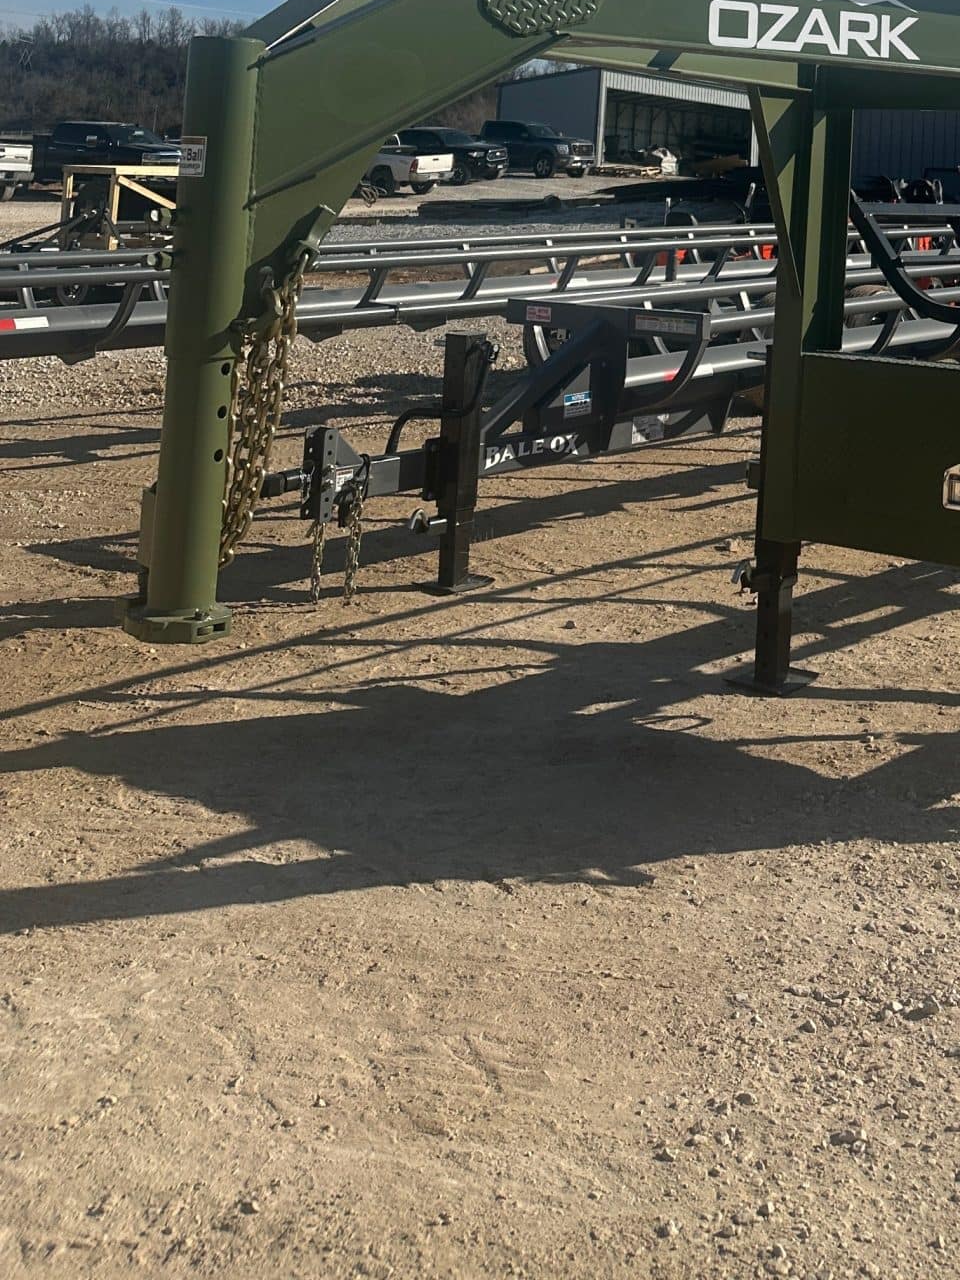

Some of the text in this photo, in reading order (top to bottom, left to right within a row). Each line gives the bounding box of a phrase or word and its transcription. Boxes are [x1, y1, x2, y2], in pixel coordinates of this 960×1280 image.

[708, 0, 920, 61] OZARK
[484, 433, 579, 470] BALE OX
